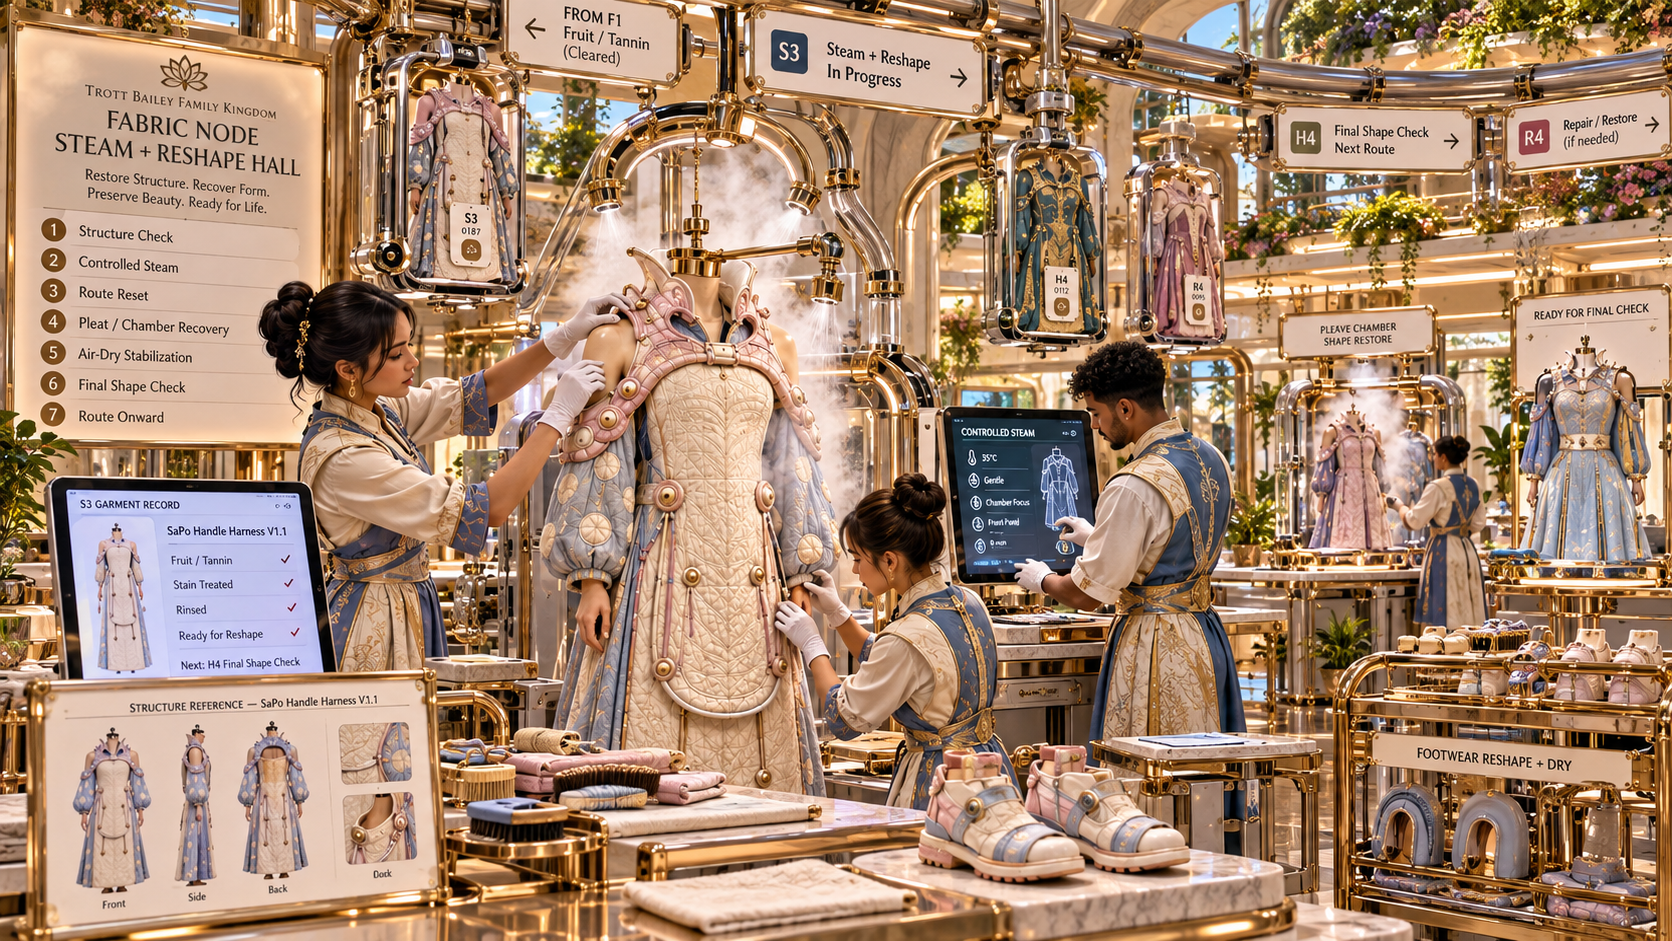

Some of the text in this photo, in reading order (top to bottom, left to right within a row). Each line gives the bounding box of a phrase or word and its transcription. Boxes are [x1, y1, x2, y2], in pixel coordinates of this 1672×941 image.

[564, 6, 620, 27] FROM F1
[564, 26, 649, 50] Fruit / Tannin
[564, 44, 620, 67] (Cleared)
[779, 42, 799, 61] S3
[827, 42, 930, 72] Steam + Reshape
[828, 64, 901, 88] In Progress
[108, 110, 258, 146] FABRIC NODE
[1564, 114, 1637, 132] Repair / Restore
[1297, 130, 1316, 145] H4
[1335, 125, 1429, 140] Final Shape Check
[1525, 129, 1544, 146] R4
[1564, 130, 1619, 150] (if needed)
[55, 133, 300, 176] STEAM + RESHAPE HALL
[1335, 142, 1395, 154] Next Route
[86, 168, 269, 197] Restore Structure. Recover Form.
[88, 187, 267, 214] Preserve Beauty. Ready for Life.
[465, 213, 477, 224] S3
[51, 223, 173, 243] 1 Structure Check
[50, 254, 178, 273] 2 Controlled Steam
[1056, 275, 1067, 284] H4
[1193, 282, 1203, 291] R4
[50, 284, 148, 301] 3 Route Reset
[1534, 303, 1649, 320] READY FOR FINAL CHECK
[48, 315, 229, 338] 4 Pleat / Chamber Recovery
[1321, 322, 1396, 334] PLEAVE CHAMBER
[1324, 335, 1392, 346] SHAPE RESTORE
[49, 346, 192, 364] 5 Air-Dry Stabilization
[49, 377, 185, 395] 6 Final Shape Check
[49, 408, 164, 423] 7 Route Onward
[961, 428, 1035, 437] CONTROLLED STEAM
[984, 476, 1004, 484] Gentle
[80, 499, 180, 509] S3 GARMENT RECORD
[986, 498, 1012, 506] Chamber
[167, 526, 286, 536] SaPo Handle Harness V1.1
[171, 556, 232, 566] Fruit / Tannin
[174, 580, 233, 589] Stain Treated
[176, 605, 206, 614] Rinsed
[179, 629, 263, 642] Ready for Reshape
[181, 657, 300, 670] Next: H4 Final Shape Check
[261, 698, 283, 708] SaPo
[286, 697, 318, 707] Handle
[321, 697, 356, 706] Harness
[1417, 747, 1479, 763] FOOTWEAR
[1483, 753, 1532, 768] RESHAPE
[1548, 759, 1572, 771] DRY
[269, 884, 288, 894] Back
[102, 900, 126, 909] Front
[188, 892, 206, 902] Side
